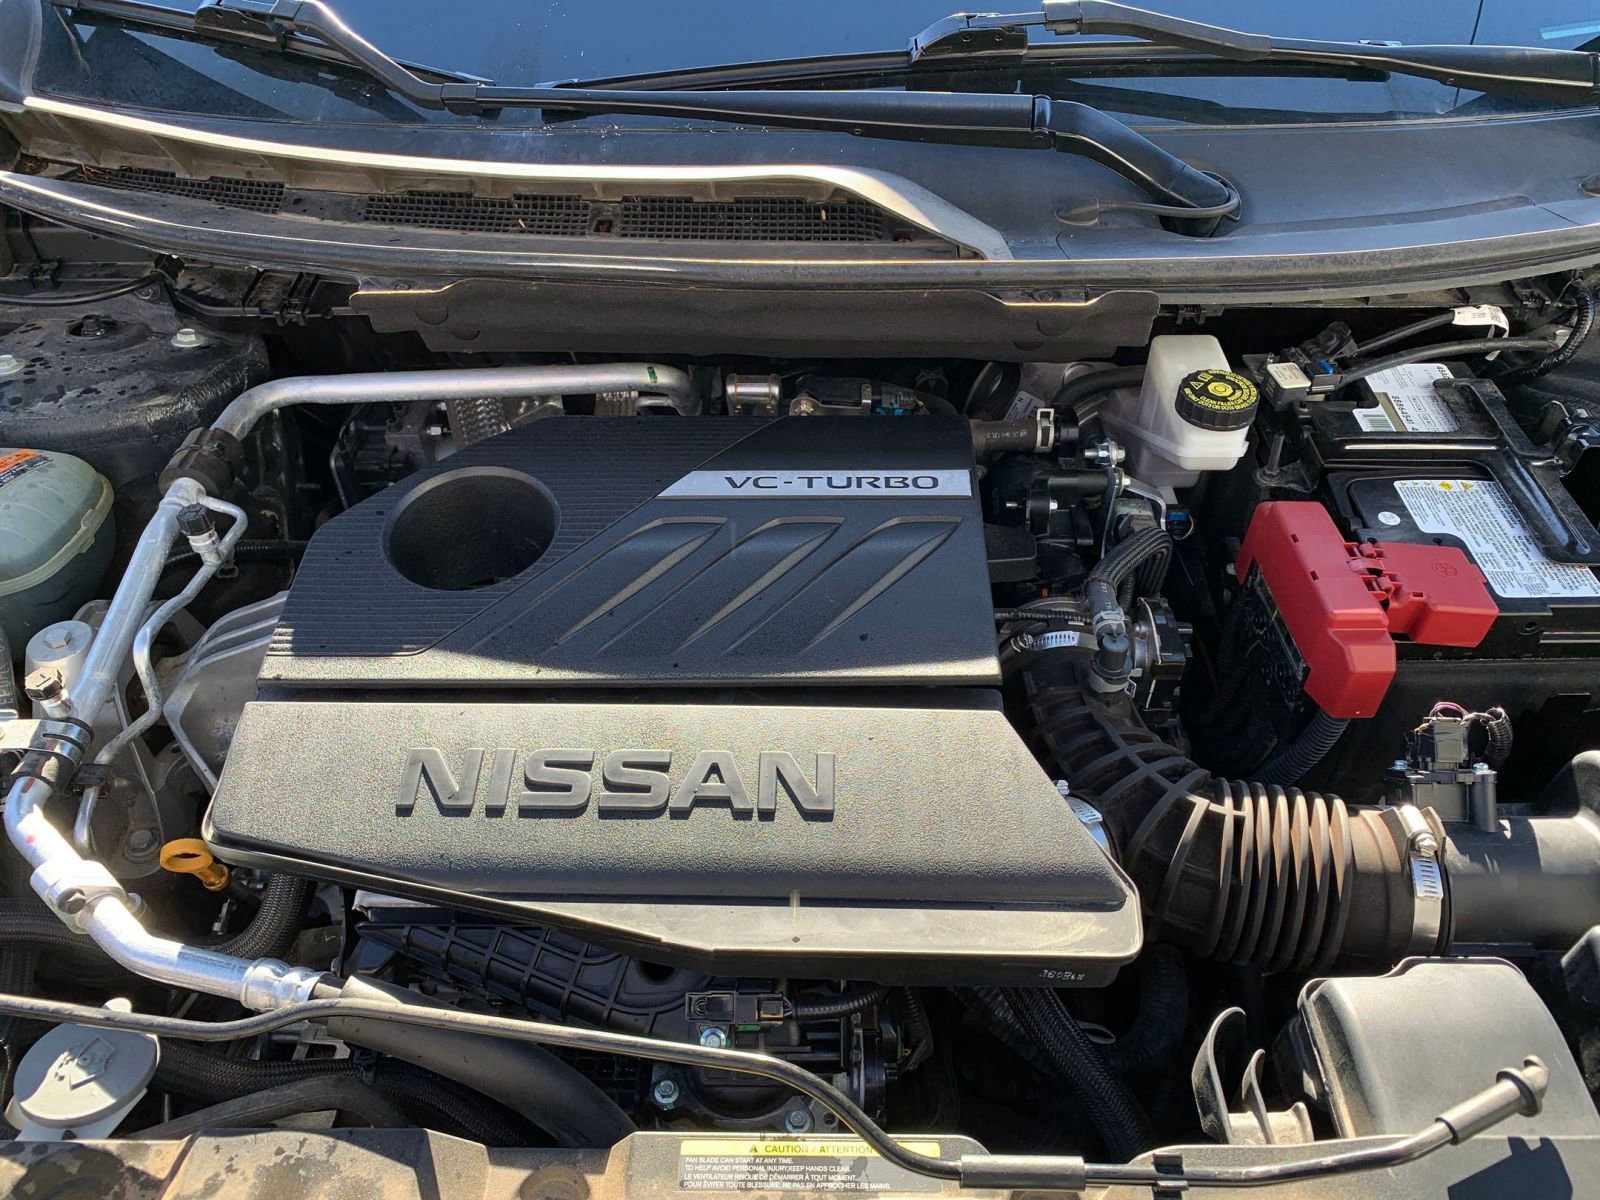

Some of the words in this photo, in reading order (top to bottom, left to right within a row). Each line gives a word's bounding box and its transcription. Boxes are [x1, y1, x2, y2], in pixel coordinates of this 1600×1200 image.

[724, 475, 939, 489] VC-TURBO
[396, 747, 835, 818] NISSAN
[764, 1145, 808, 1153] CAUTION
[819, 1146, 873, 1154] ATTENTION
